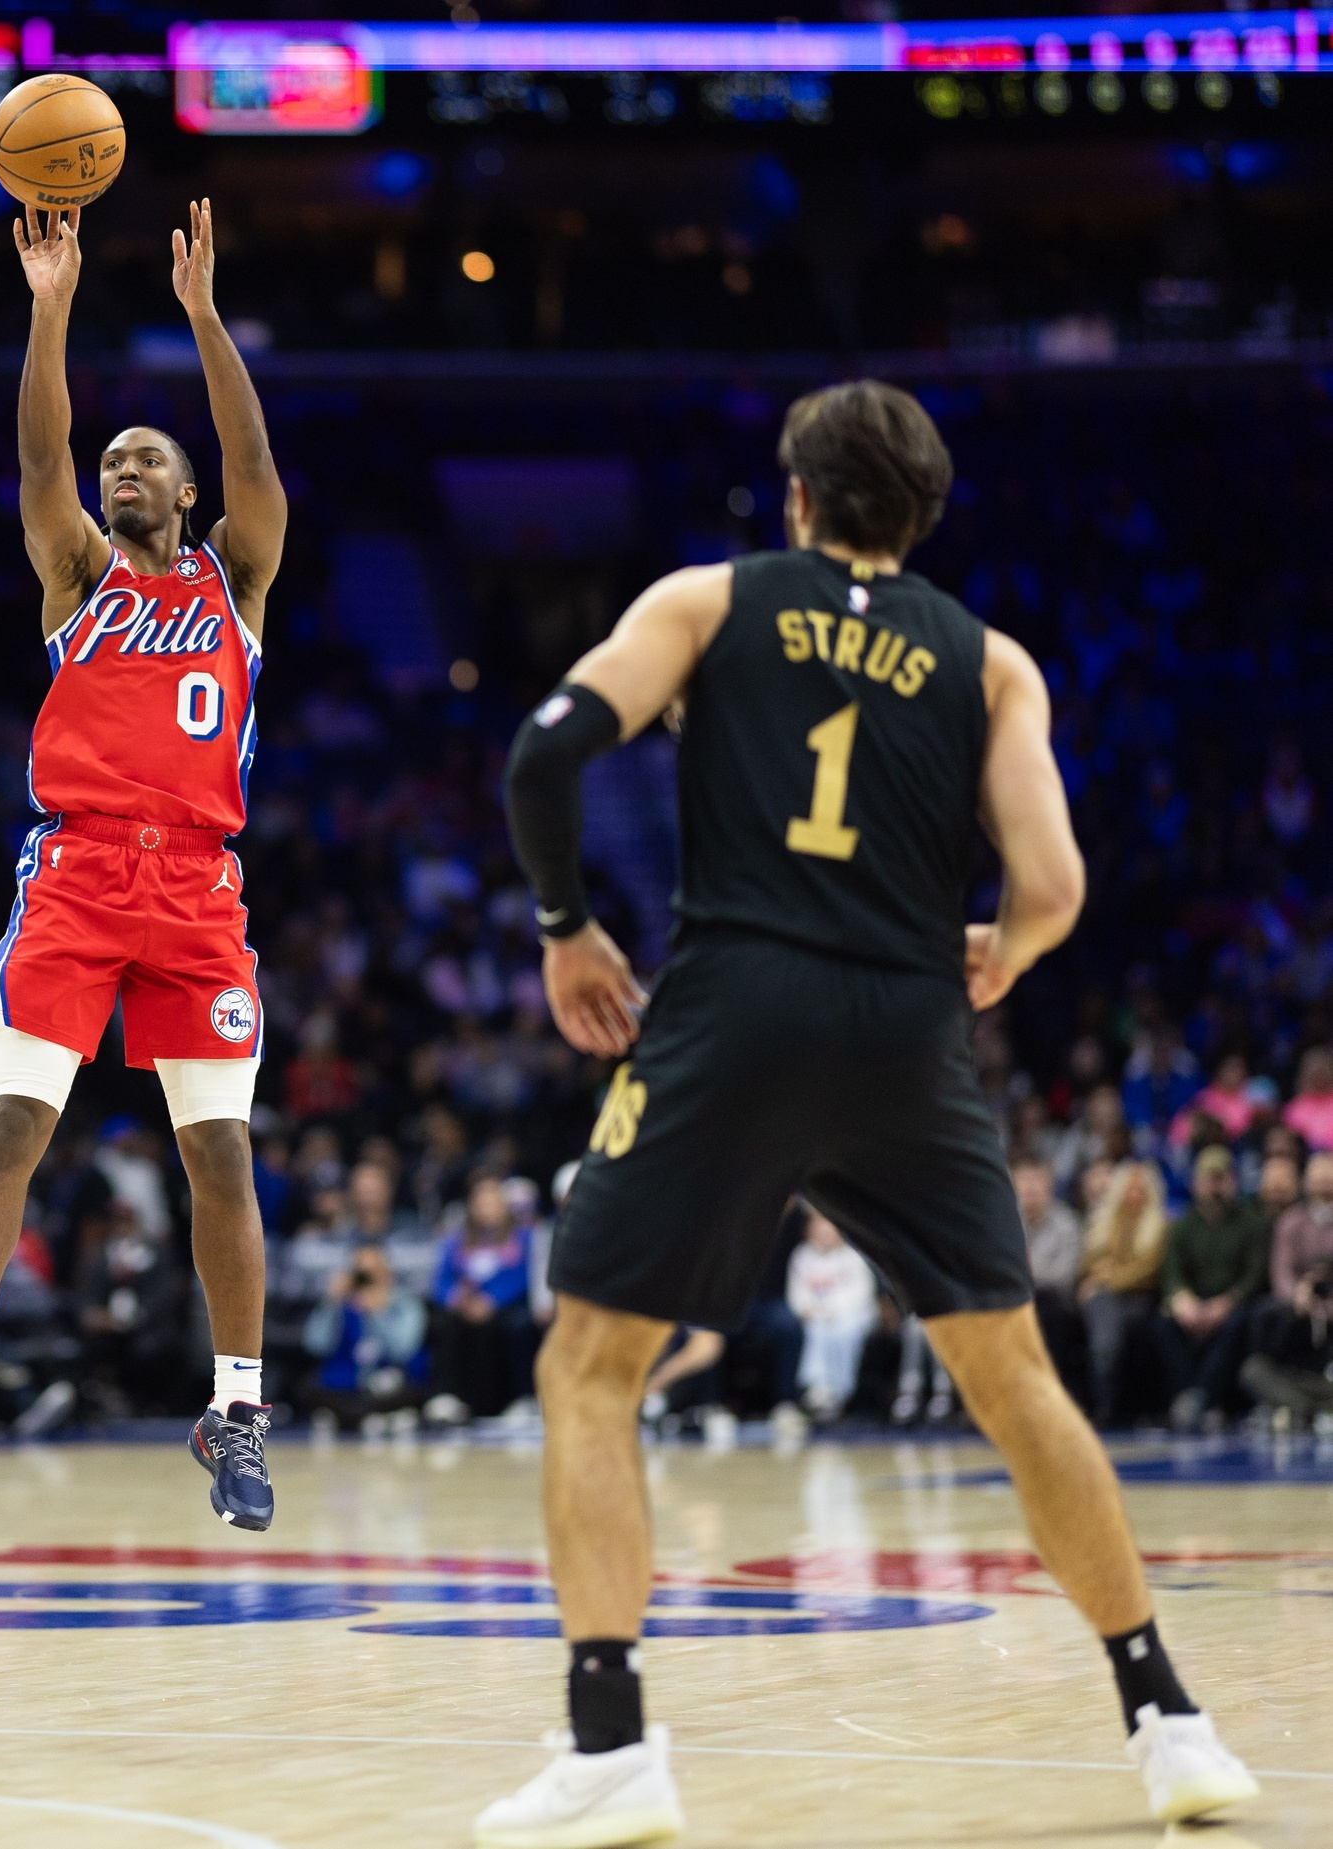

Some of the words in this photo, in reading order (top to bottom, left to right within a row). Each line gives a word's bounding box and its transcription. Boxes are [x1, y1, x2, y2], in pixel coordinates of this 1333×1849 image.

[72, 587, 225, 664] Phila
[776, 608, 938, 698] STRUS
[176, 671, 225, 742] 0
[785, 700, 861, 862] 1
[218, 1007, 252, 1028] 76ers
